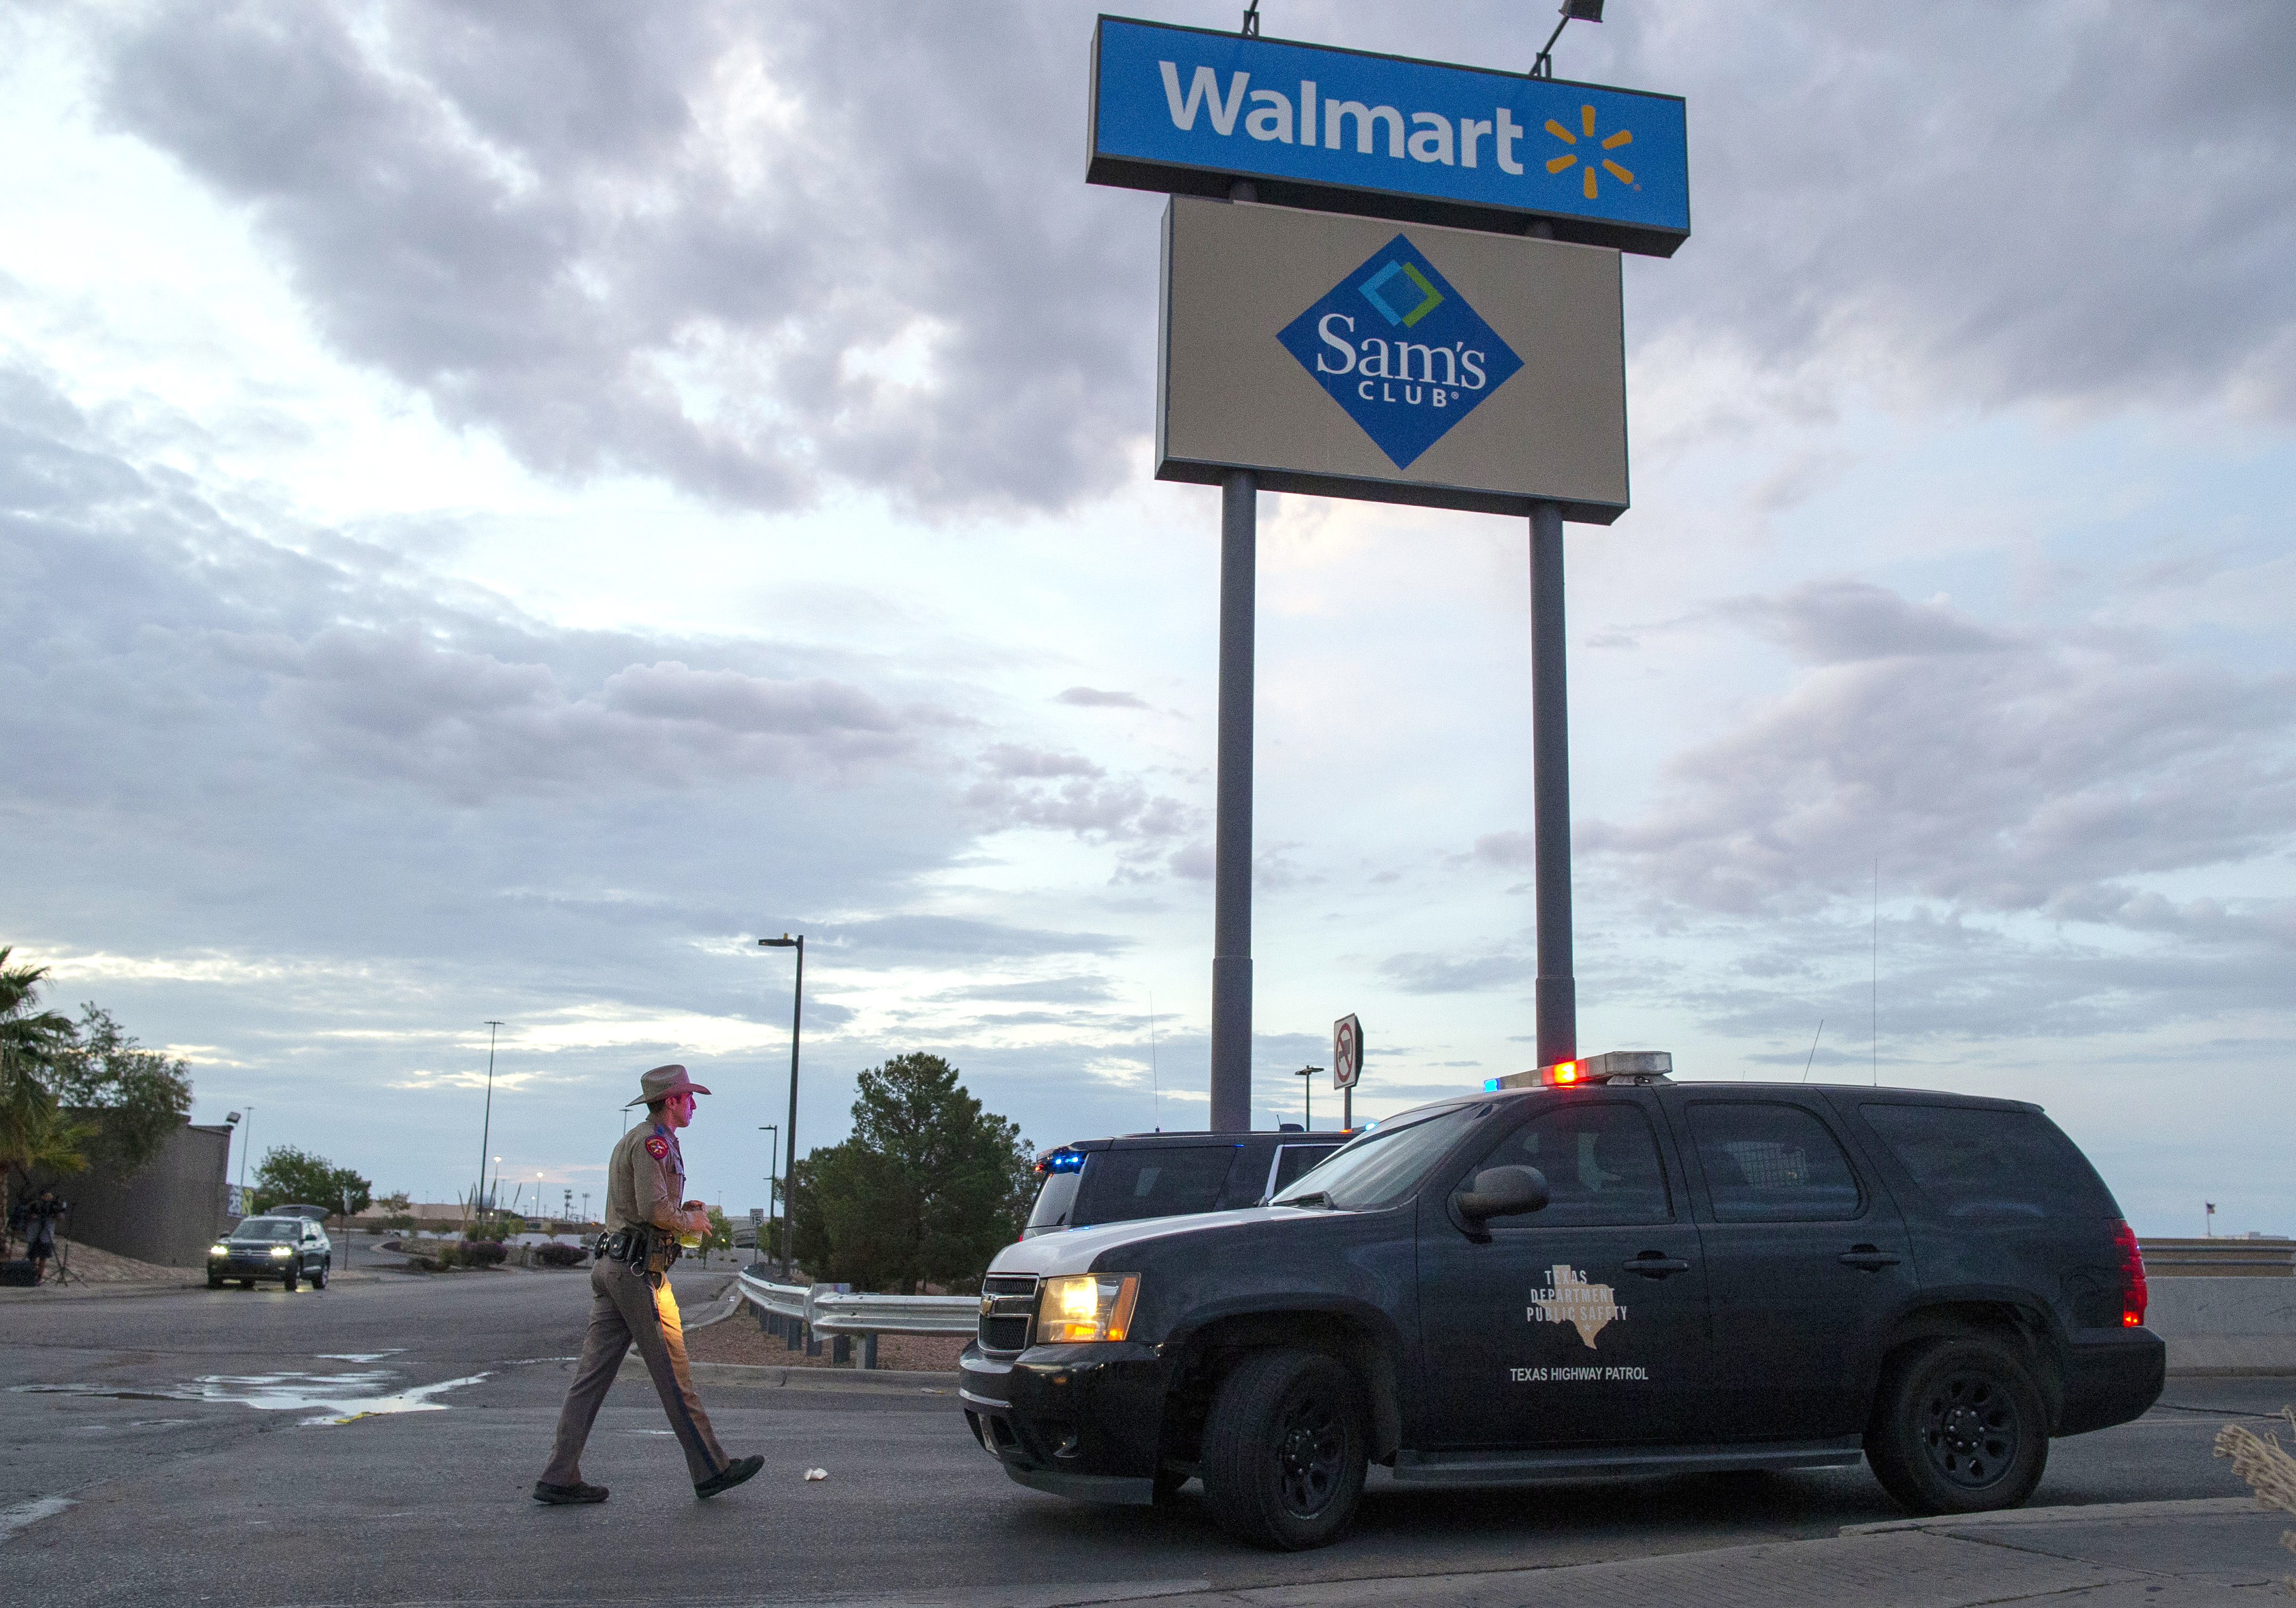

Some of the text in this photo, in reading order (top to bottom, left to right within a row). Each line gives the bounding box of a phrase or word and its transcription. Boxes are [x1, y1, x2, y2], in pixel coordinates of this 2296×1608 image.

[1158, 60, 1523, 175] Walmart
[1317, 313, 1486, 390] Sam's
[751, 1216, 762, 1225] 15
[1545, 1270, 1587, 1285] TEXAS
[1530, 1287, 1615, 1303] DEPARTMENT
[1526, 1306, 1627, 1322] PUBLIC SAFETY
[1509, 1367, 1649, 1381] TEXAS HIGHWAY PATROL
